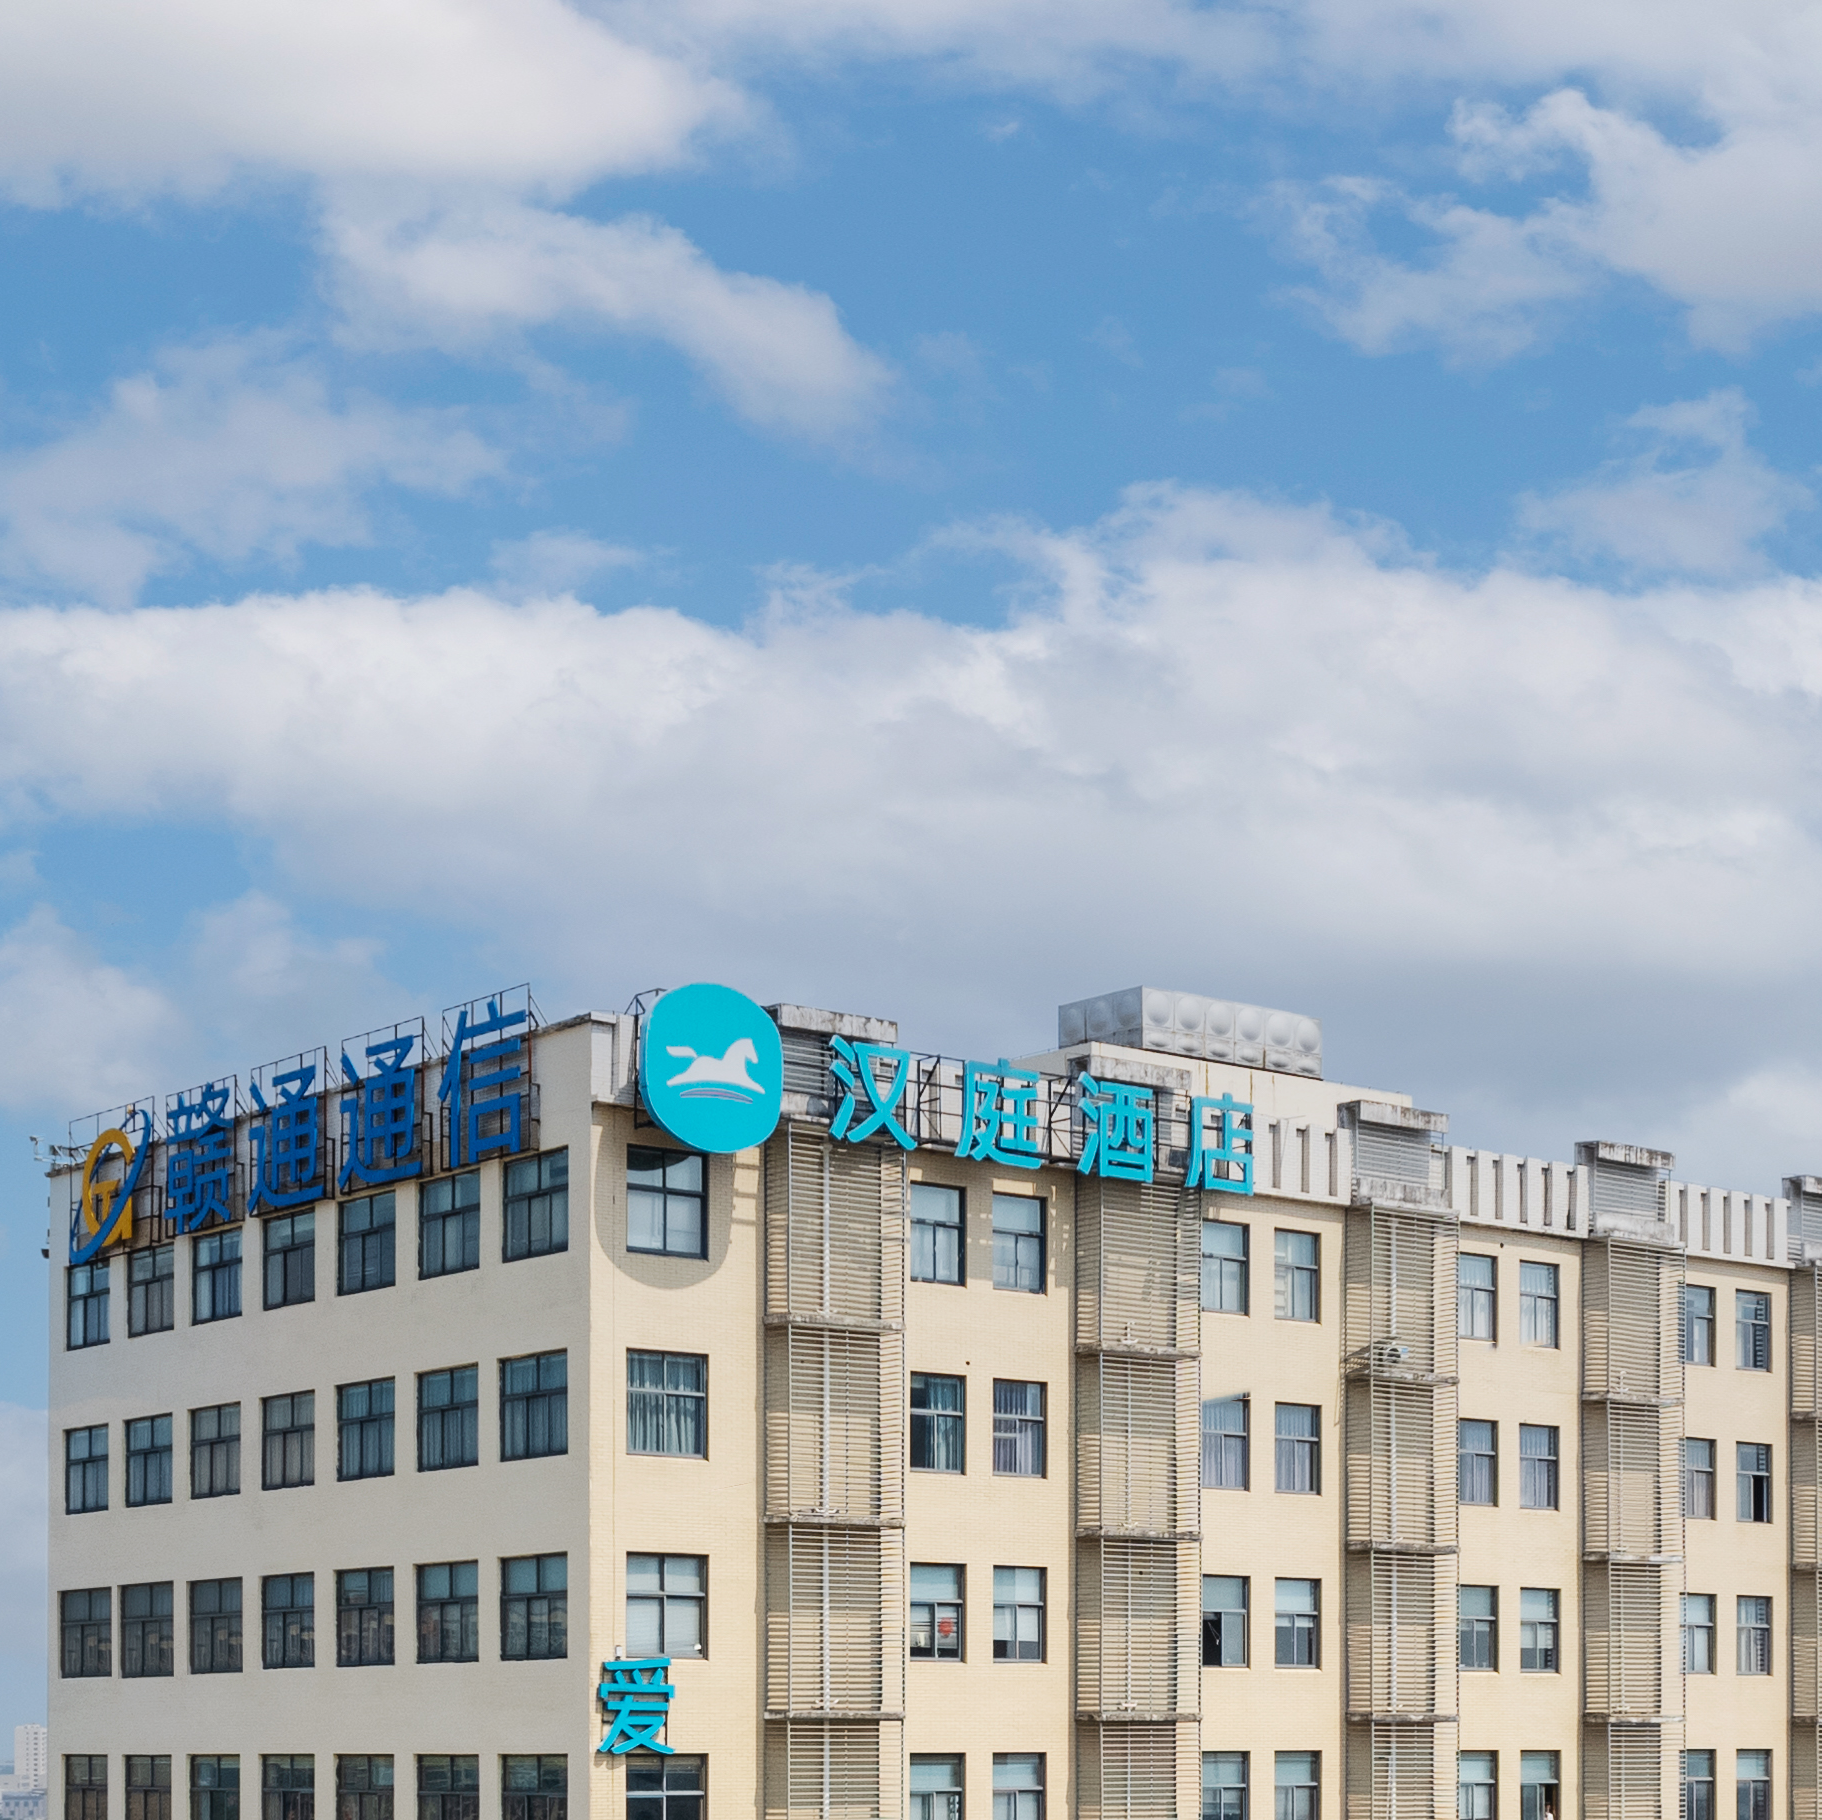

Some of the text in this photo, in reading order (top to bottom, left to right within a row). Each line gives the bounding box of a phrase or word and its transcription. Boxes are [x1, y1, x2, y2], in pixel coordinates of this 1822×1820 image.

[165, 999, 527, 1234] 赣通通信
[829, 1035, 1256, 1197] 汉庭酒店
